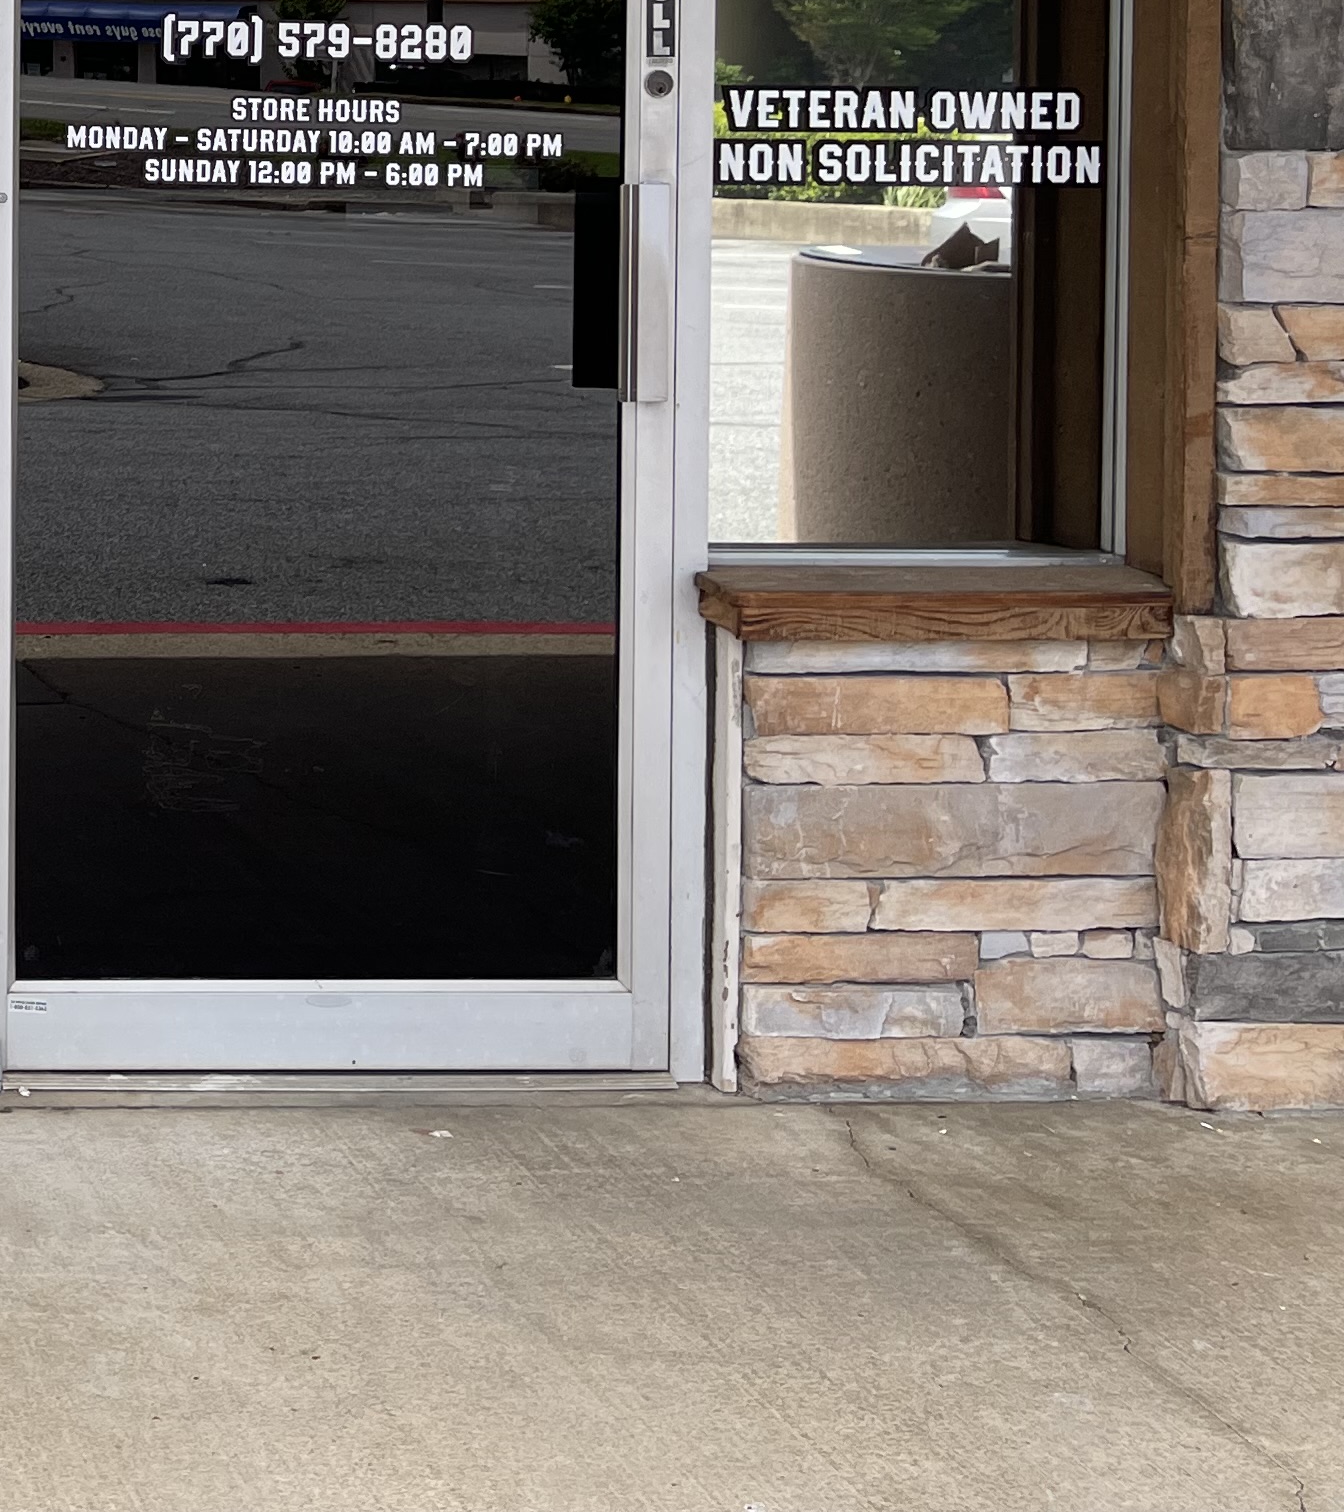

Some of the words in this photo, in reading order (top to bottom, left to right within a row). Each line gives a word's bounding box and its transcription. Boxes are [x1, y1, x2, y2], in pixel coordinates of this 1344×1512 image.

[276, 21, 473, 64] 579-8280
[232, 98, 311, 124] STORE
[317, 99, 401, 125] HOURS
[725, 88, 917, 131] VETERAN
[928, 89, 1084, 132] OWNED
[66, 126, 167, 152] MONDAY
[196, 128, 320, 155] SATURDAY
[328, 129, 393, 155] 10:00
[399, 130, 435, 156] AM
[464, 132, 519, 157] 7:00
[526, 133, 563, 158] PM
[144, 158, 240, 184] SUNDAY
[247, 159, 311, 185] 12:00
[319, 161, 356, 186] PM
[385, 161, 440, 187] 6:00
[447, 163, 484, 188] PM
[718, 142, 803, 185] NON
[816, 142, 1102, 186] SOLICITATION
